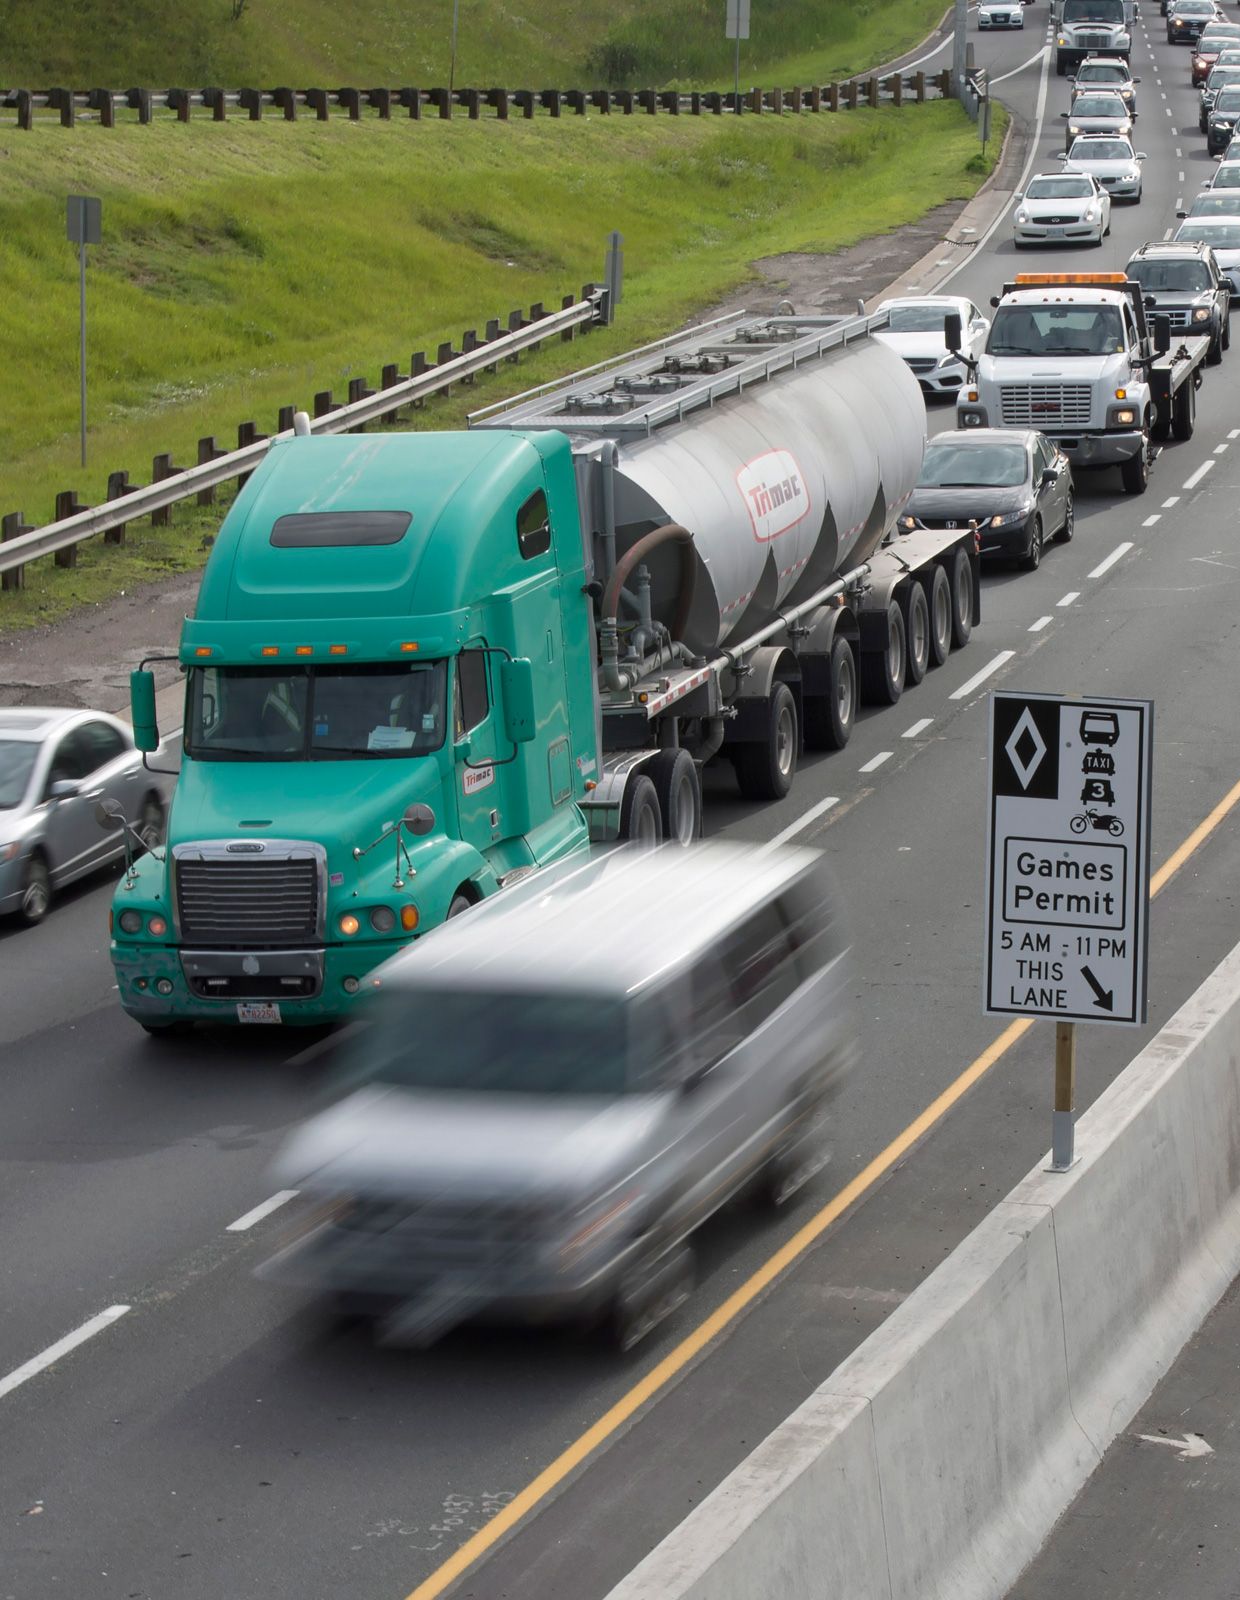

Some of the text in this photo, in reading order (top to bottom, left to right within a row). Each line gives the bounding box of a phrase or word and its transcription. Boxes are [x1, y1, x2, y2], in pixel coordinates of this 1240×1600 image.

[748, 474, 801, 518] Trimac
[1087, 756, 1110, 770] TAXI
[465, 767, 491, 788] Trimac
[1091, 782, 1105, 799] 3
[1016, 852, 1114, 882] Games
[1014, 885, 1114, 916] Permit
[1000, 931, 1013, 950] 5
[1020, 933, 1051, 953] AM
[1076, 936, 1091, 956] 11
[1098, 938, 1127, 959] PM
[1016, 960, 1063, 982] THIS
[1010, 986, 1068, 1009] LANE
